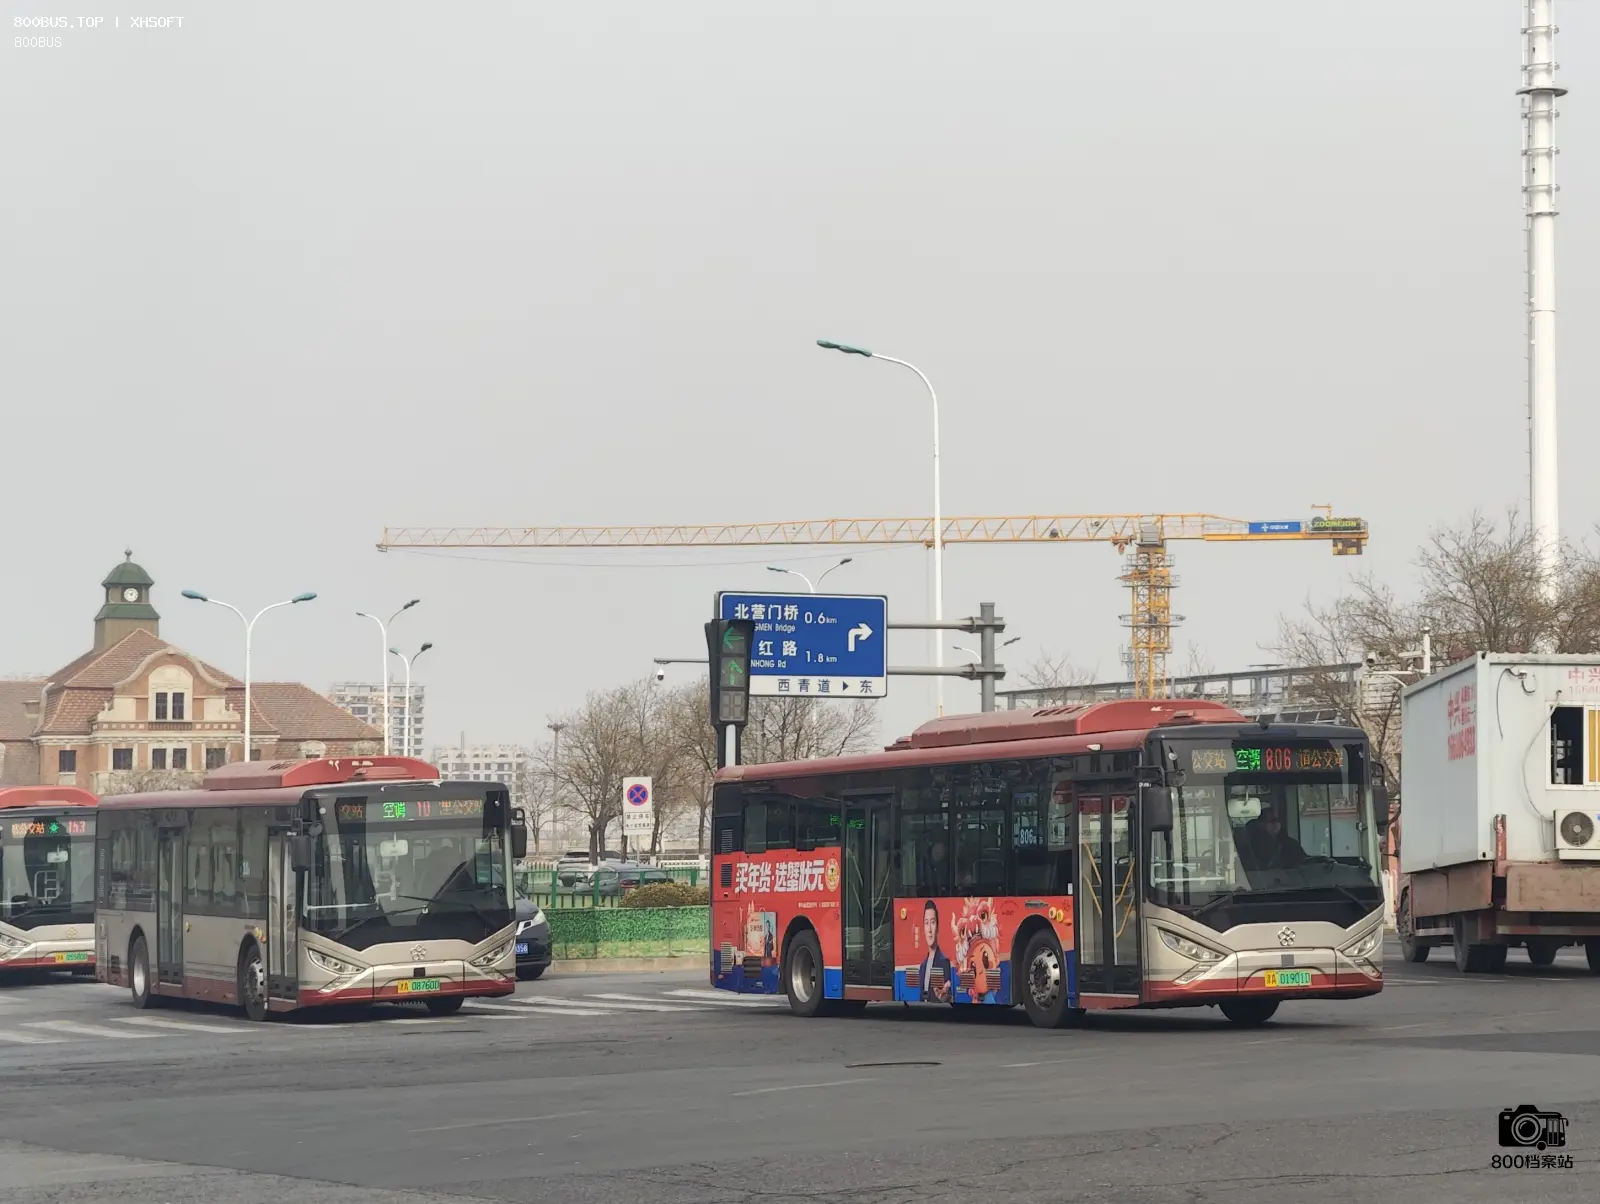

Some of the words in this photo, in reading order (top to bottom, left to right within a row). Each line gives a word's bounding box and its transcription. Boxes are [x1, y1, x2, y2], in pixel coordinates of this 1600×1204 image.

[734, 603, 799, 621] 北营门桥
[754, 622, 773, 632] GMEN
[775, 622, 796, 634] Bridge
[758, 640, 798, 656] 红路
[805, 650, 824, 663] 1.8
[750, 659, 775, 668] NHONG
[778, 660, 786, 669] Rd
[778, 678, 831, 693] 西青道
[860, 680, 873, 693] 东
[1265, 748, 1292, 770] 806
[382, 801, 406, 818] 空调
[416, 800, 431, 816] 10
[1020, 828, 1033, 845] 806
[734, 860, 825, 893] 买年货·选蟹状元
